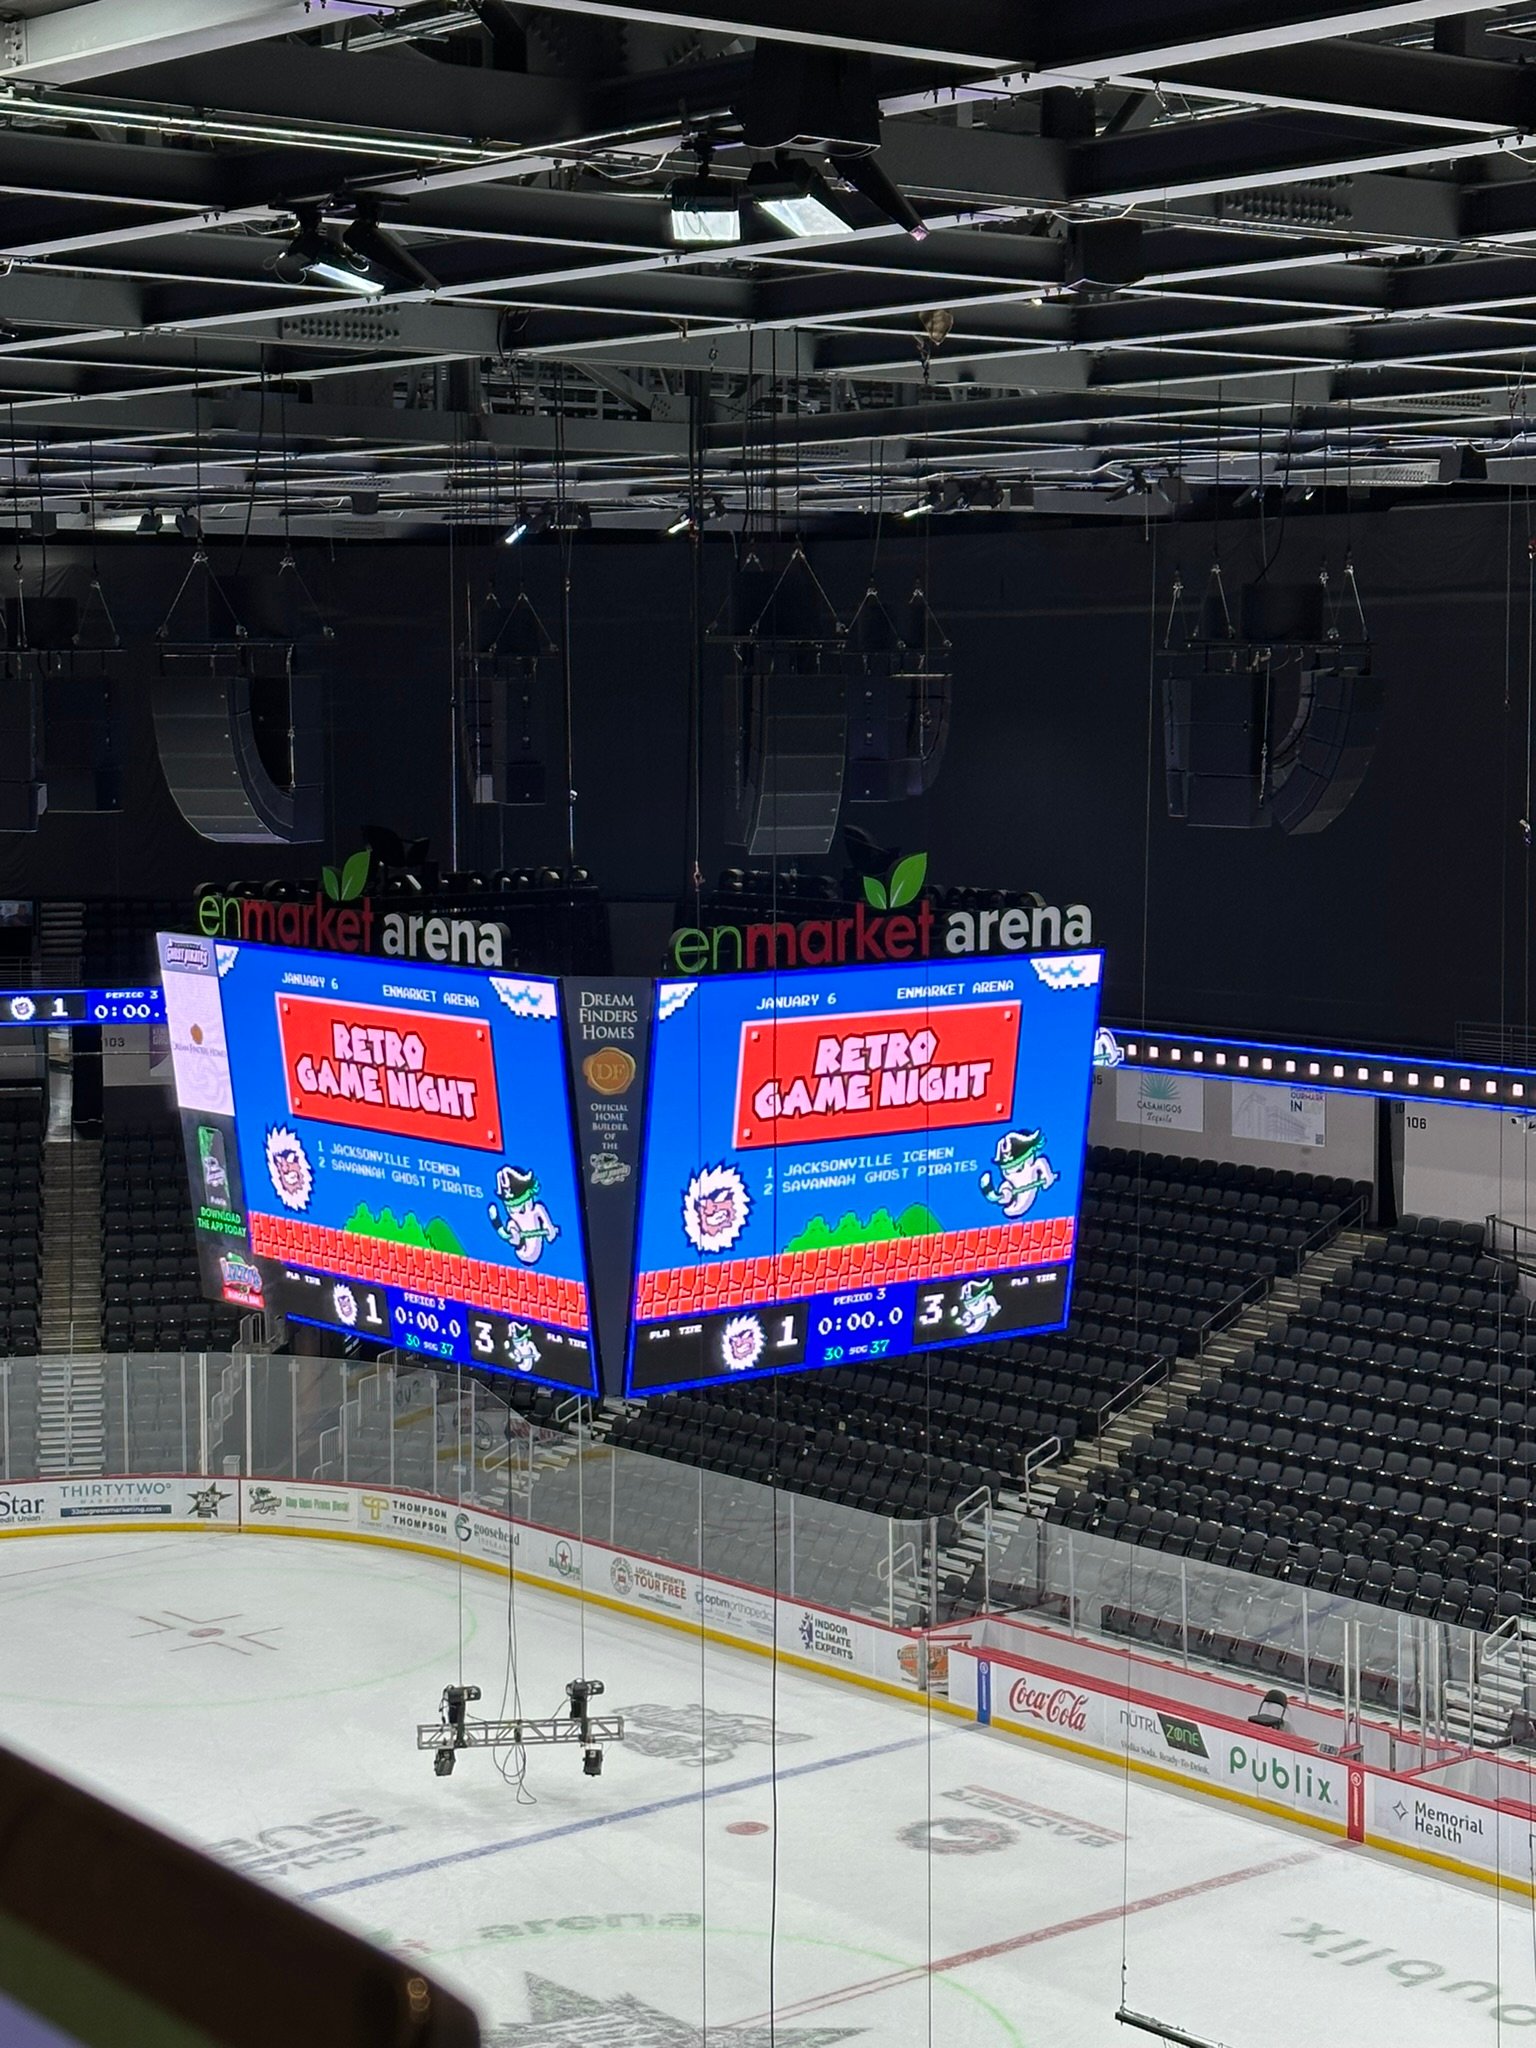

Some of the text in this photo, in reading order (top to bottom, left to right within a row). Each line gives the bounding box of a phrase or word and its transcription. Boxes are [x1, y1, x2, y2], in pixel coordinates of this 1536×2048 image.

[944, 904, 1093, 954] arena
[382, 913, 504, 967] arena
[281, 973, 339, 990] JANUARY 6
[897, 979, 1014, 1000] ENMARKET ARENA
[105, 990, 158, 999] PERIOD 3
[382, 984, 480, 1008] ENMARKET ARENA
[581, 991, 634, 1007] DREAM
[756, 993, 837, 1011] JANUARY 6
[51, 998, 68, 1017] 1
[94, 1004, 168, 1018] 0:00.
[579, 1009, 638, 1023] FINDERS
[104, 1037, 125, 1047] 103
[583, 1025, 635, 1040] HOMES
[330, 1019, 426, 1071] RETRO
[812, 1027, 940, 1078] RETRO
[295, 1053, 477, 1121] GAME NIGHT
[752, 1058, 994, 1121] GAME NIGHT
[590, 1102, 629, 1112] OFFICIAL
[1137, 1101, 1182, 1114] CASAMIGOS
[1290, 1099, 1303, 1112] IN
[592, 1122, 629, 1131] BUILDER
[595, 1112, 625, 1122] HOME
[1147, 1112, 1172, 1123] Tequila
[1406, 1116, 1427, 1129] 106
[602, 1142, 618, 1150] THE
[604, 1132, 616, 1140] OF
[318, 1140, 461, 1177] 1 JACKSONVILLE ICEMEN
[766, 1147, 954, 1178] 1 JACKSONVILLE ICEMEN
[318, 1156, 483, 1199] 2 SAVANNAH GHOST PIRATES
[764, 1160, 978, 1196] 2 SAVANNAH GHOST PIRATES
[200, 1206, 241, 1224] DOWNLOAD
[404, 1293, 446, 1311] PERIOD 3
[833, 1288, 886, 1306] PERIOD 3
[366, 1293, 381, 1324] 1
[919, 1294, 945, 1326] 3
[395, 1307, 461, 1338] 0:00.0
[776, 1315, 799, 1348] 1
[817, 1307, 903, 1336] 0:00.0
[405, 1334, 421, 1348] 30
[440, 1343, 454, 1356] 37
[475, 1321, 495, 1353] 3
[823, 1346, 844, 1361] 30
[869, 1339, 890, 1354] 37
[17, 1514, 41, 1522] Union
[392, 1500, 448, 1519] THOMPSON
[392, 1515, 448, 1535] THOMPSON
[634, 1574, 662, 1592] TOUR
[663, 1582, 687, 1600] FREE
[814, 1619, 848, 1636] INDOOR
[814, 1630, 851, 1648] CLIMATE
[814, 1642, 854, 1660] EXPERTS
[1009, 1677, 1089, 1732] Coca-Cola
[1165, 1723, 1200, 1747] ZONE
[1229, 1745, 1332, 1804] Publix
[1414, 1800, 1484, 1835] Memorial
[1414, 1818, 1462, 1844] Health
[476, 1912, 700, 1939] arena
